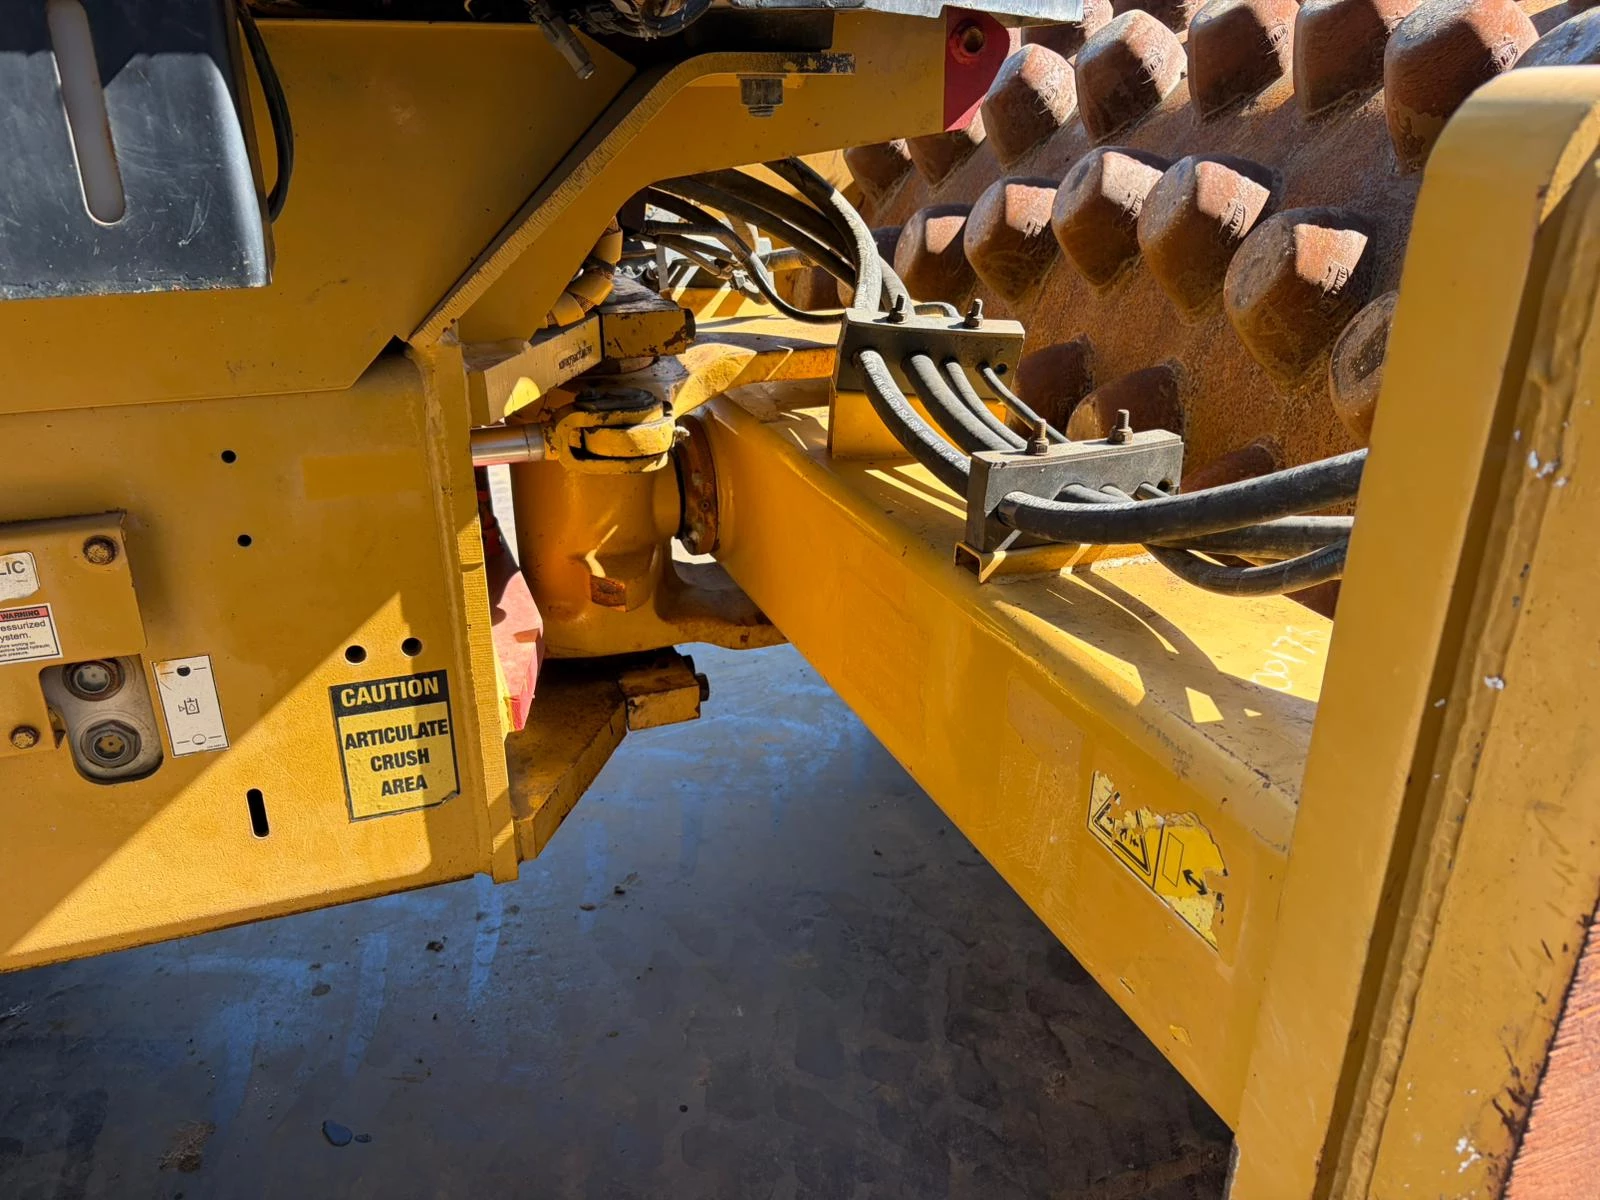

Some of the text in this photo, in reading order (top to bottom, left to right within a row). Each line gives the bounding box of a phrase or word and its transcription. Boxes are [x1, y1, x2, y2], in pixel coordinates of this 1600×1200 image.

[0, 609, 41, 620] WARNING
[340, 676, 440, 708] CAUTION
[345, 718, 449, 750] ARTICULATE
[370, 747, 430, 772] CRUSH
[381, 774, 428, 797] AREA
